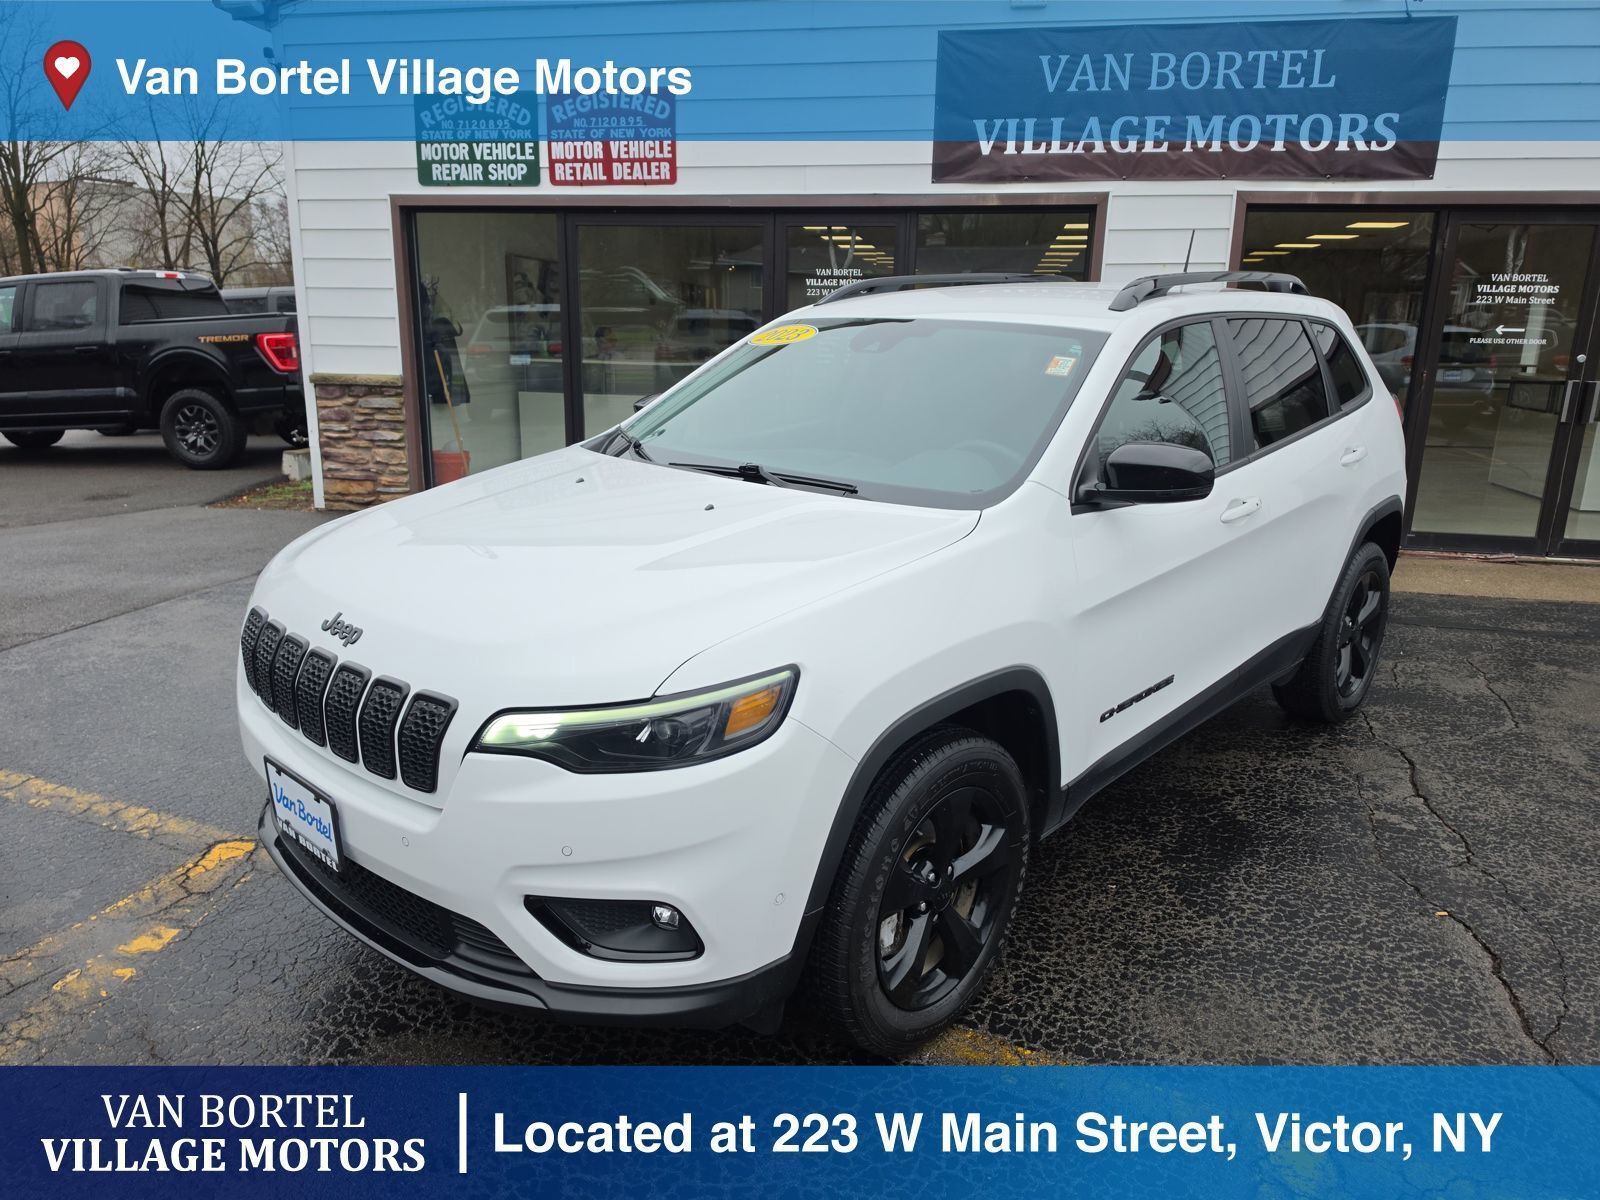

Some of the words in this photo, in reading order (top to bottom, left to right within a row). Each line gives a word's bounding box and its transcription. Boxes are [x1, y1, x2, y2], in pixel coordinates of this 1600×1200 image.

[1039, 53, 1134, 92] VAN
[1147, 50, 1336, 91] BORTEL
[457, 119, 511, 129] 7120895
[589, 116, 643, 127] 7120895
[421, 130, 454, 140] STATE
[457, 130, 468, 139] OF
[474, 130, 498, 139] NEW
[502, 129, 532, 139] YORK
[551, 129, 586, 139] STATE
[590, 129, 605, 138] OF
[610, 129, 635, 138] NEW
[639, 127, 672, 137] YORK
[973, 115, 1171, 156] VILLAGE
[1182, 113, 1400, 153] MOTORS
[420, 143, 469, 161] MOTOR
[472, 142, 535, 160] VEHICLE
[550, 141, 604, 160] MOTOR
[610, 140, 673, 159] VEHICLE
[431, 163, 483, 181] REPAIR
[488, 163, 528, 180] SHOP
[554, 162, 607, 180] RETAIL
[612, 161, 671, 180] DEALER
[815, 268, 832, 276] VAN
[833, 268, 863, 276] BORTEL
[1491, 273, 1511, 282] VAN
[1512, 273, 1549, 282] BORTEL
[805, 278, 838, 286] VILLAGE
[806, 288, 820, 296] 223
[821, 288, 830, 296] W
[1476, 284, 1517, 293] VILLAGE
[1518, 284, 1560, 294] MOTORS
[1475, 295, 1493, 304] 223
[1494, 295, 1505, 304] W
[1505, 295, 1528, 304] Main
[1529, 295, 1556, 305] Street
[198, 335, 249, 343] TREMOR
[1493, 337, 1506, 345] USE
[321, 611, 364, 648] Jeep
[273, 782, 298, 816] Van
[296, 798, 333, 842] Bortel
